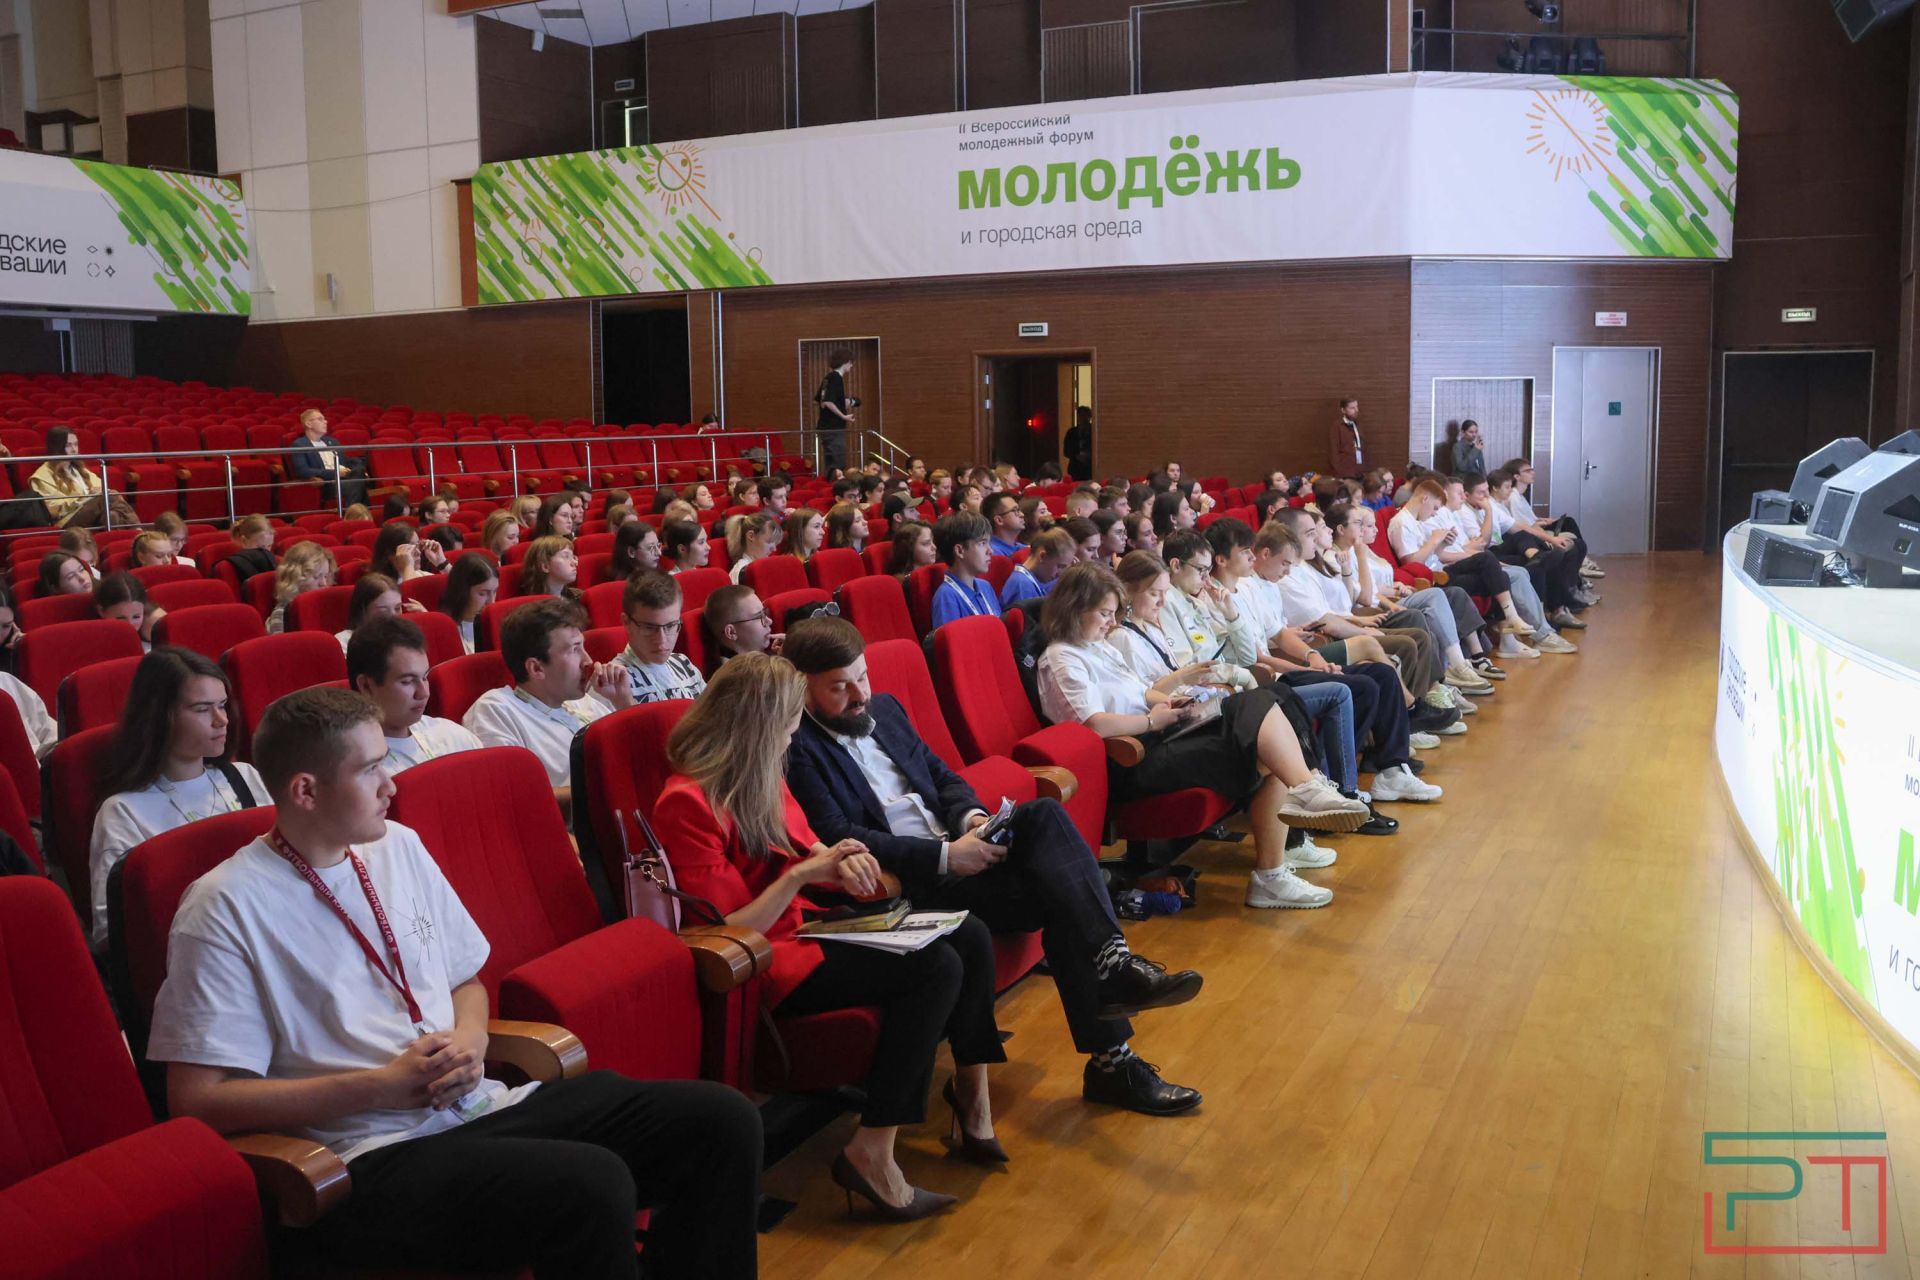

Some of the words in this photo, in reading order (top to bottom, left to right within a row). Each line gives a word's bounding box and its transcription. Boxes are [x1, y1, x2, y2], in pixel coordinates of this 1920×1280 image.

[971, 113, 1071, 134] Всероссийский
[959, 132, 1044, 151] молодежный
[1049, 130, 1094, 146] форум
[958, 134, 1302, 210] молодёжь
[961, 230, 972, 245] и
[979, 223, 1077, 248] городская
[1084, 218, 1143, 242] среда
[0, 254, 67, 276] вации
[1904, 773, 1920, 798] мо
[1888, 943, 1900, 974] и
